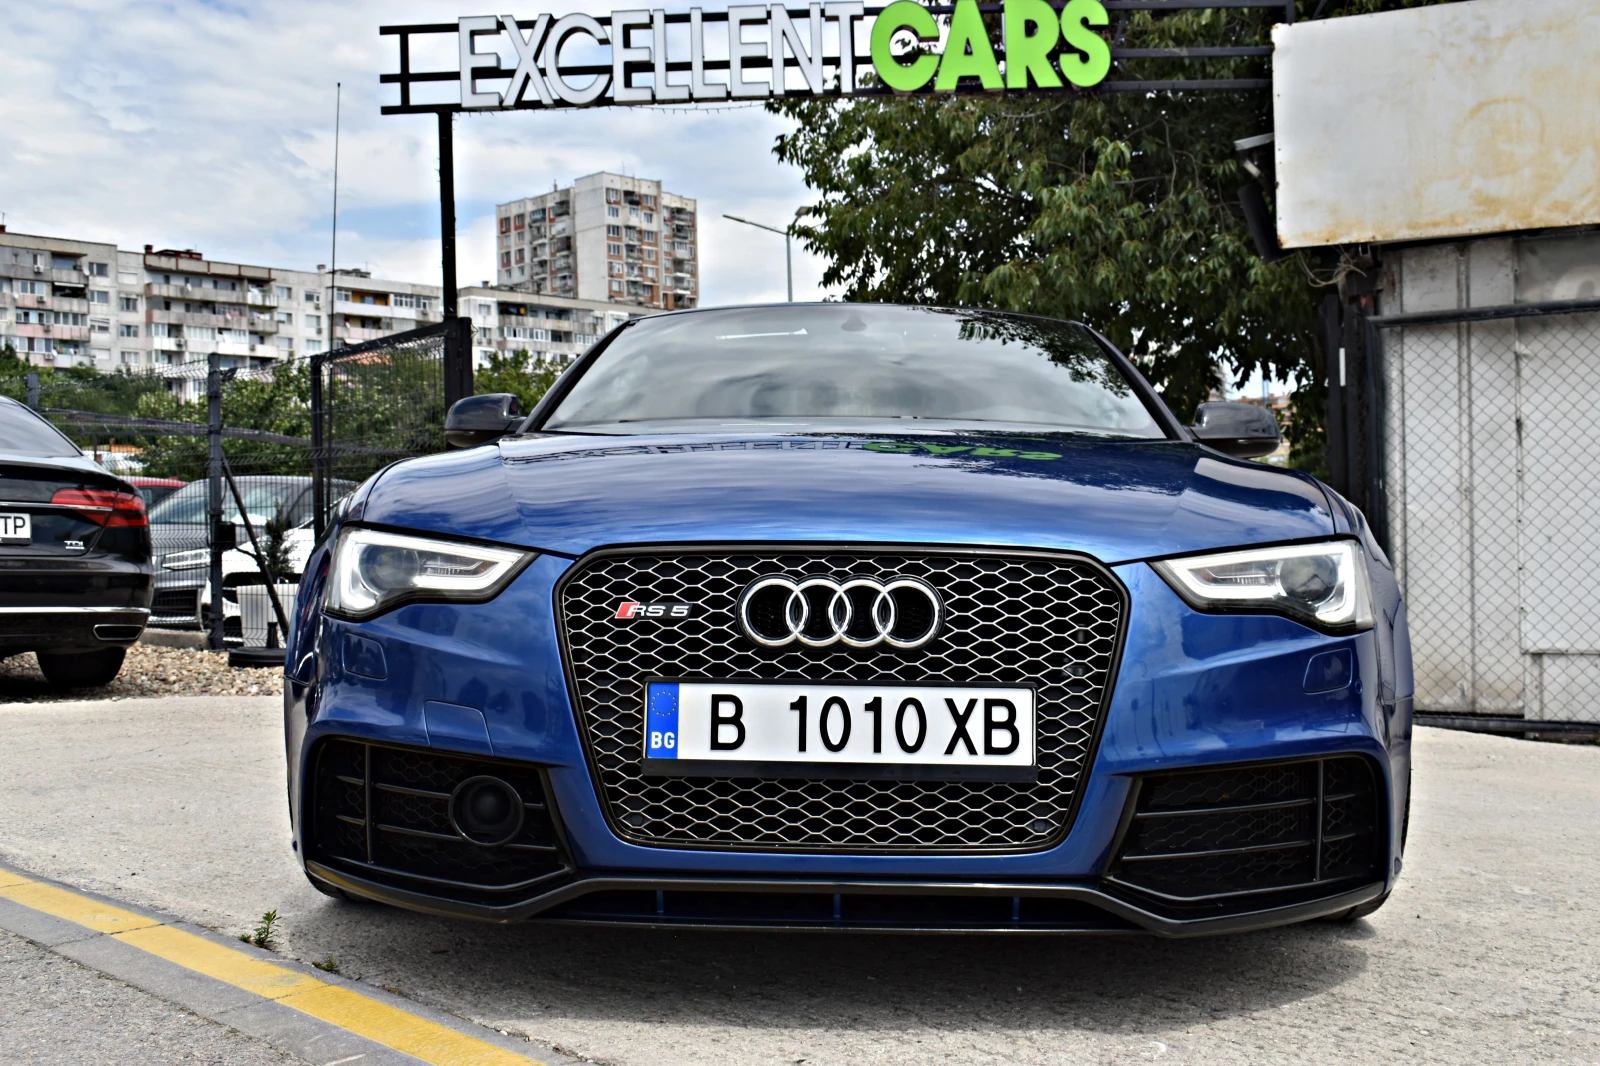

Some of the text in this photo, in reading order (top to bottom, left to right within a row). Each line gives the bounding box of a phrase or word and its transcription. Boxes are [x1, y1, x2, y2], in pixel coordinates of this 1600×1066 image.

[458, 0, 1112, 108] EXCELLENT CARS
[626, 605, 690, 617] RS 5
[650, 731, 676, 749] BG
[709, 693, 1020, 756] B 1010 XB
